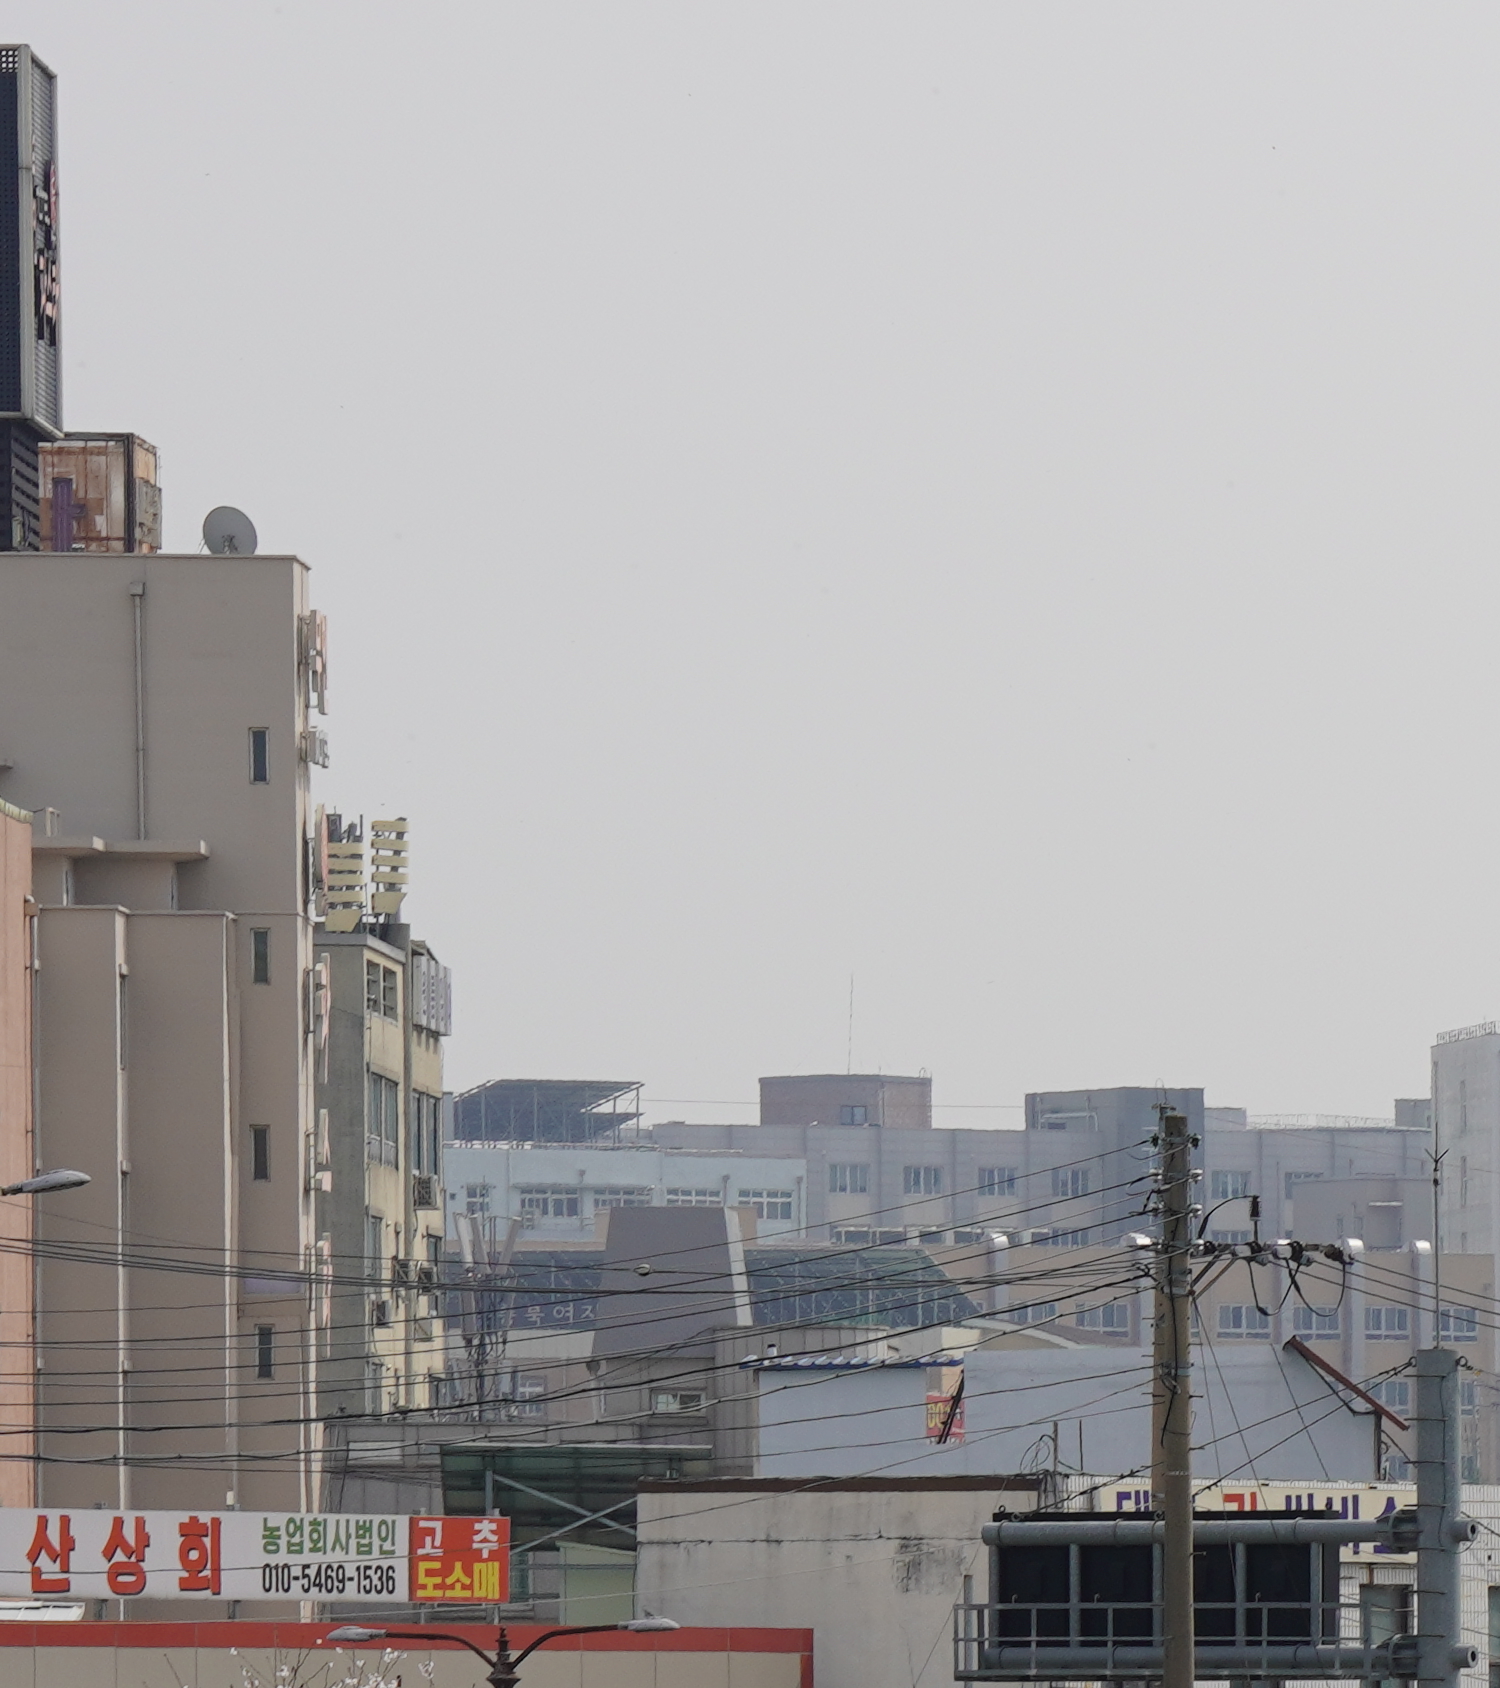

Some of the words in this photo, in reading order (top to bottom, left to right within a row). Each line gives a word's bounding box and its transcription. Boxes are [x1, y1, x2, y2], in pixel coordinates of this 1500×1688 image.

[261, 1516, 398, 1555] 농업회사법인
[261, 1561, 396, 1595] 010-5469-1536
[418, 1561, 500, 1600] 도소매
